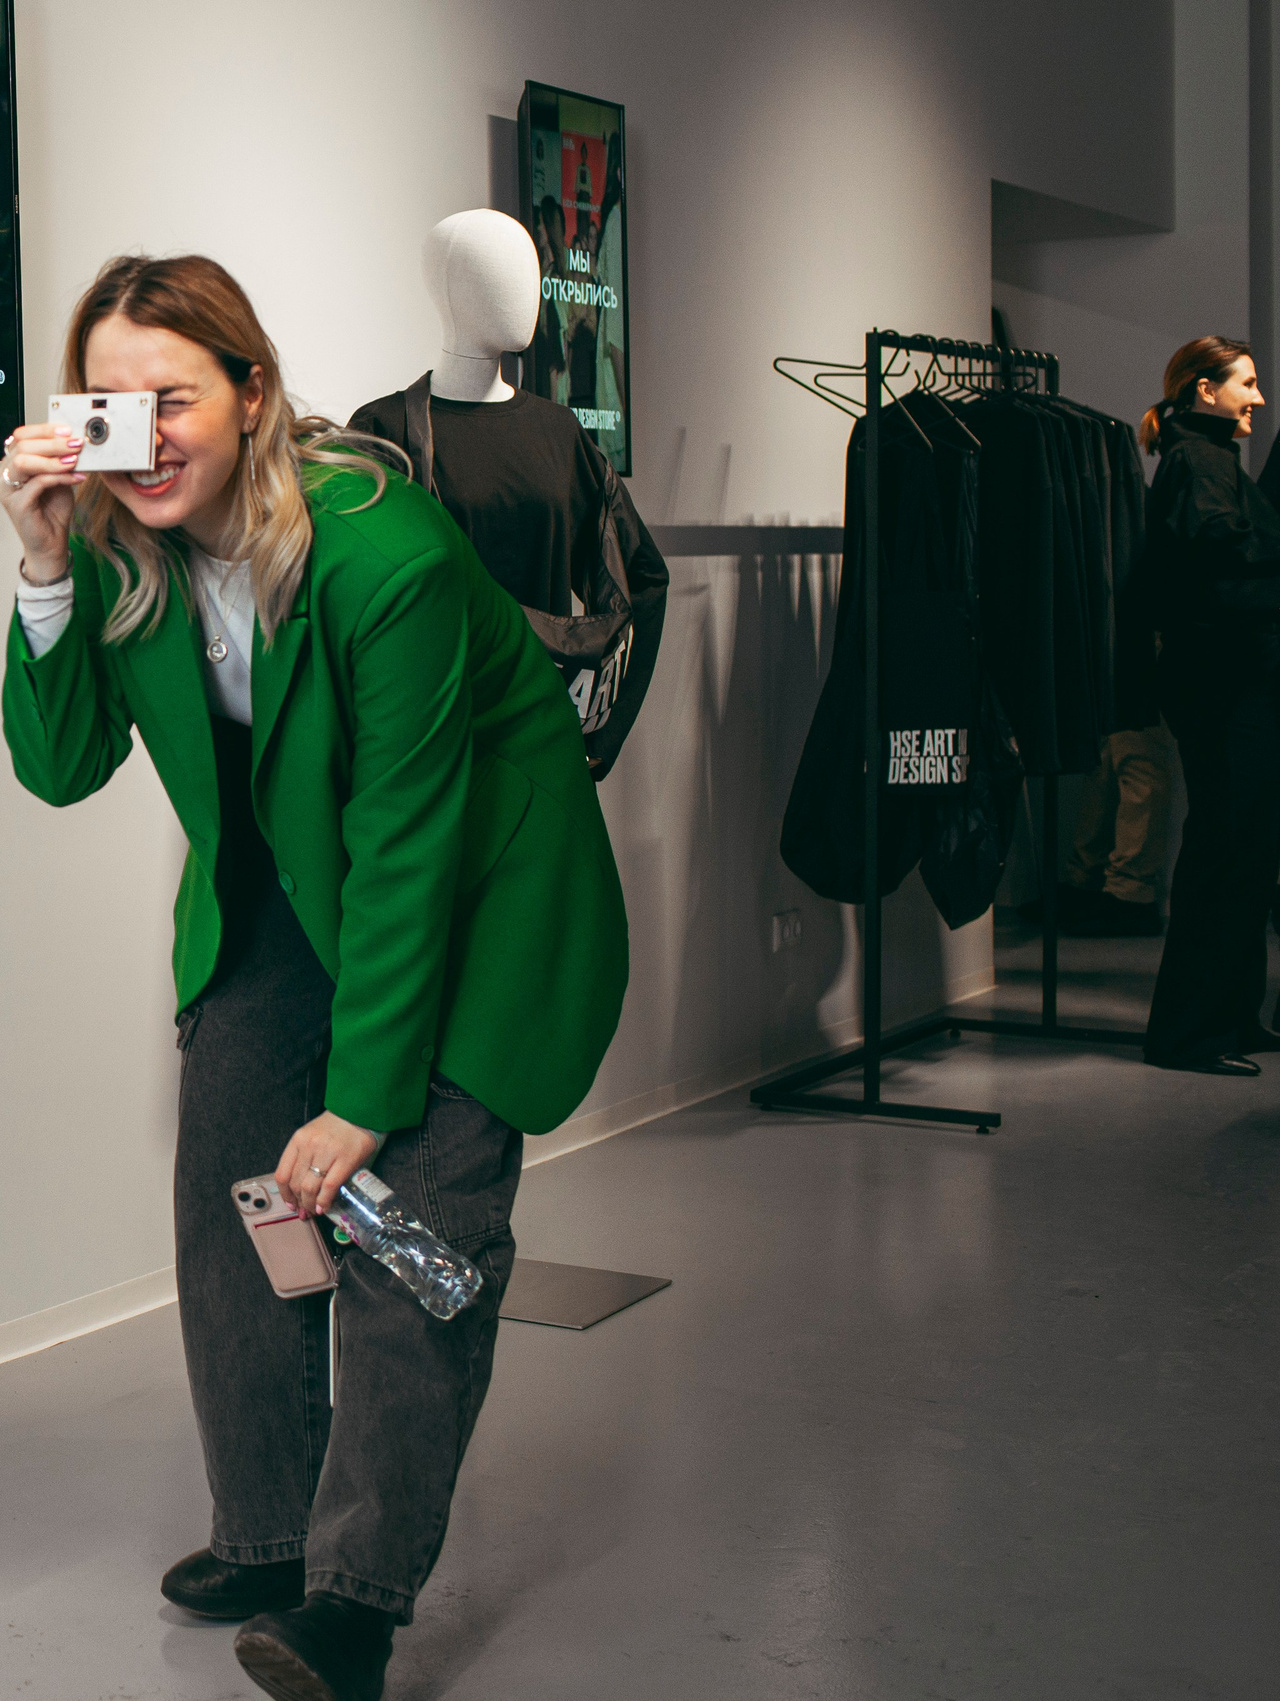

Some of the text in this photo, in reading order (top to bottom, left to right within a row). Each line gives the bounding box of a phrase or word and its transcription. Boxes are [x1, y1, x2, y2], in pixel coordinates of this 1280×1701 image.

[569, 248, 590, 274] МЫ
[541, 276, 618, 309] ОТКРЫЛИСЬ
[568, 640, 626, 734] ART
[889, 730, 921, 757] HSE
[923, 729, 956, 756] ART
[887, 756, 948, 784] DESIGN
